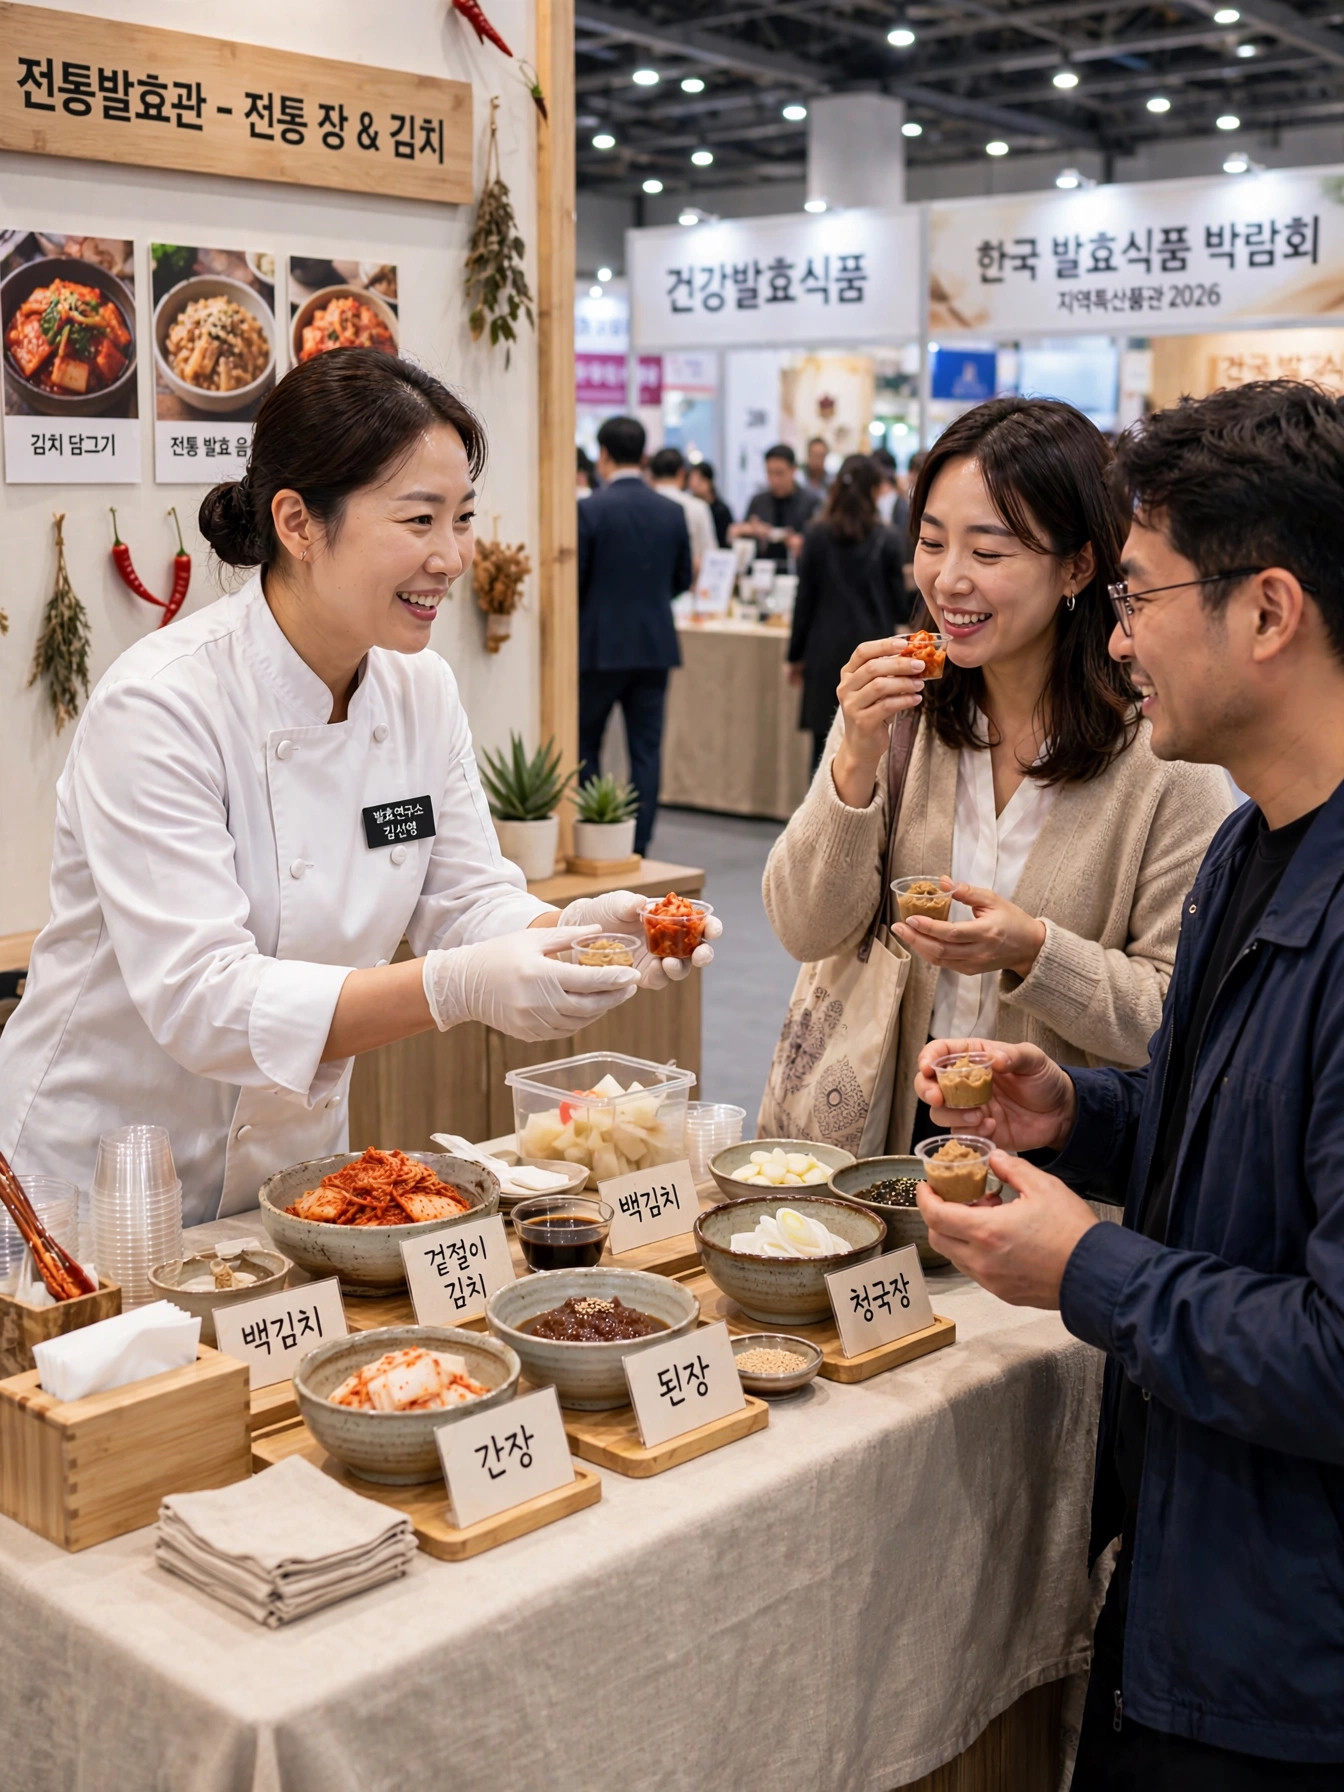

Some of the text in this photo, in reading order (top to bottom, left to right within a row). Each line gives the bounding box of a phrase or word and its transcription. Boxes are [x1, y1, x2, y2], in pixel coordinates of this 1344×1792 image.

[16, 56, 207, 132] 전통발효관
[244, 91, 308, 146] 전통
[317, 103, 349, 151] 장
[356, 111, 380, 152] &
[389, 113, 446, 165] 김치
[976, 214, 1321, 285] 한국 발효식품 박람회
[666, 254, 869, 315] 건강발효식품
[1058, 282, 1222, 315] 지역특산품관 2026
[31, 433, 116, 457] 김치 담그기
[170, 436, 253, 458] 전통 발효 음
[373, 803, 424, 824] 발효연구소
[383, 820, 418, 840] 김선영
[618, 1183, 681, 1223] 백김치
[423, 1234, 488, 1277] 겉절이
[443, 1272, 488, 1310] 김치
[849, 1272, 911, 1323] 청국장
[240, 1305, 324, 1356] 백김치
[657, 1354, 711, 1407] 된장
[474, 1424, 535, 1480] 간장
